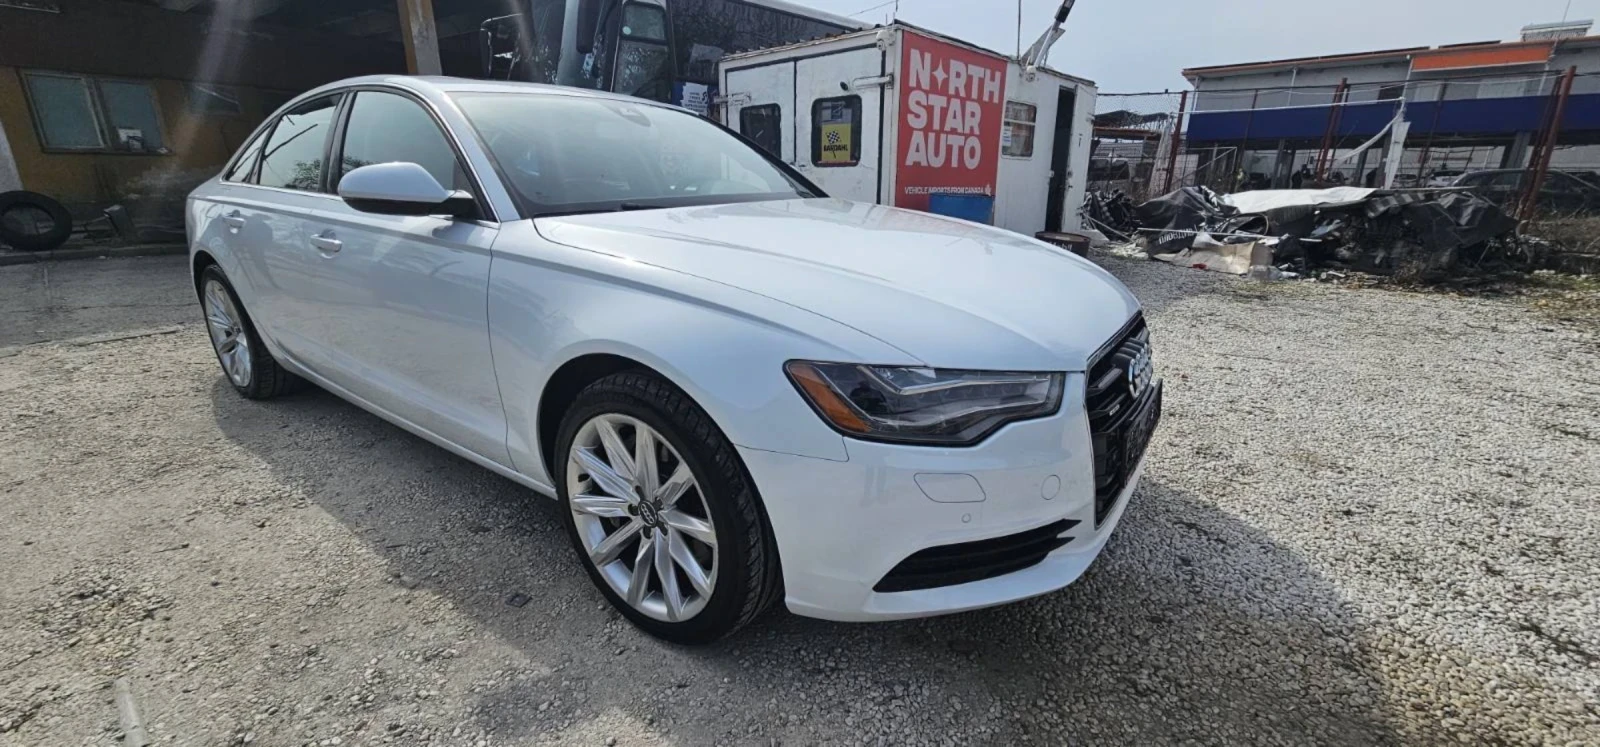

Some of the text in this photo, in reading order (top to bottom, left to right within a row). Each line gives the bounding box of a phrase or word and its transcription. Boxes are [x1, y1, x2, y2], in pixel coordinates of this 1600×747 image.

[907, 90, 982, 135] STAR
[905, 130, 981, 170] AUTO
[904, 186, 928, 195] VEHICLE
[965, 186, 983, 194] CANADA
